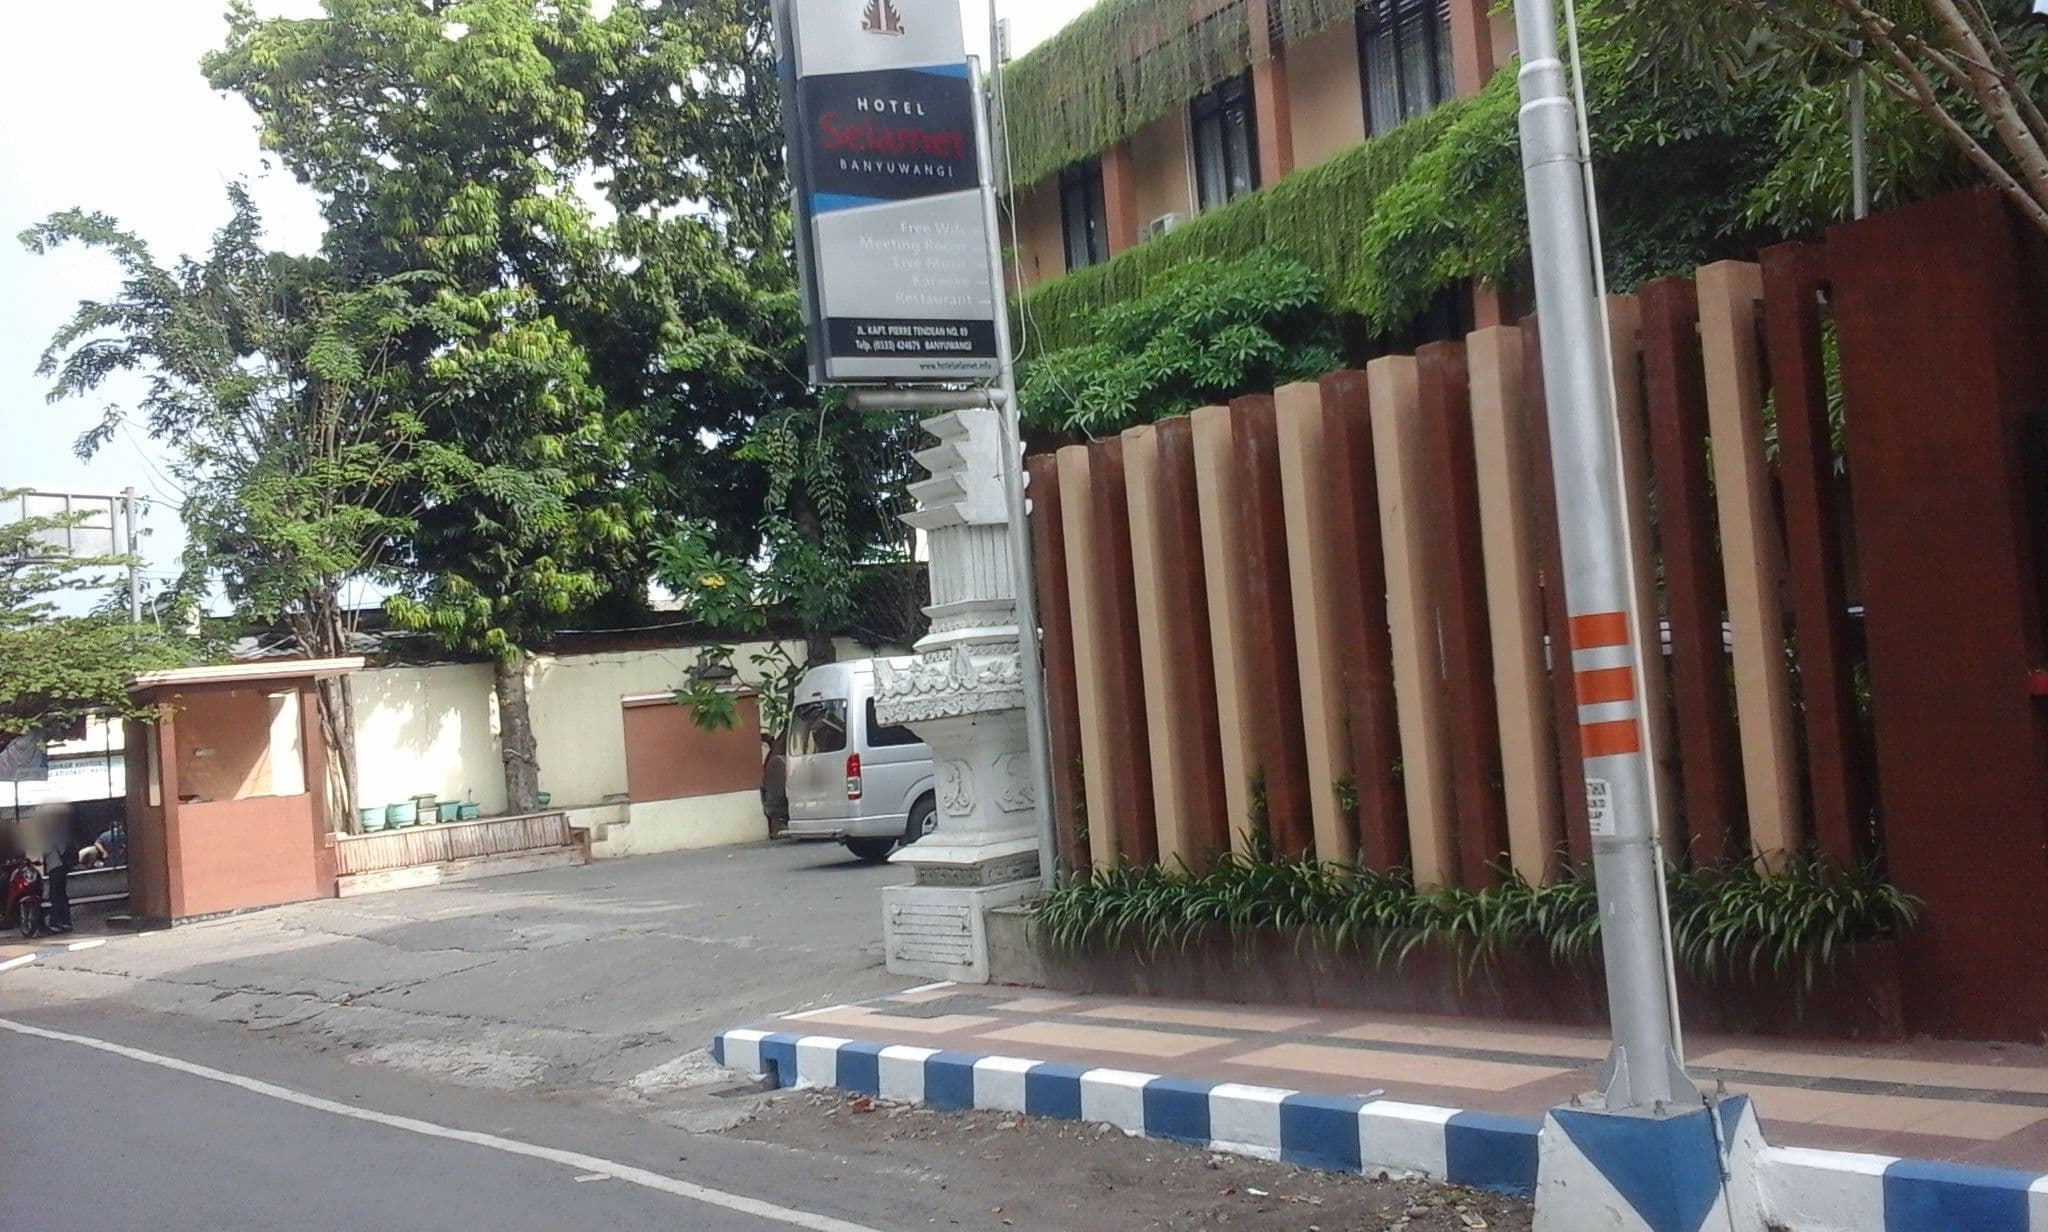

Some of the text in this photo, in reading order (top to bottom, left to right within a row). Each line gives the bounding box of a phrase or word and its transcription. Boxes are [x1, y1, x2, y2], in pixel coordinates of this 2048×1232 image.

[857, 97, 925, 116] HOTEL
[820, 112, 967, 160] Selamet
[840, 158, 953, 177] BANYUWANGI
[859, 235, 920, 257] Meeting
[925, 341, 972, 351] BANYUWANGI
